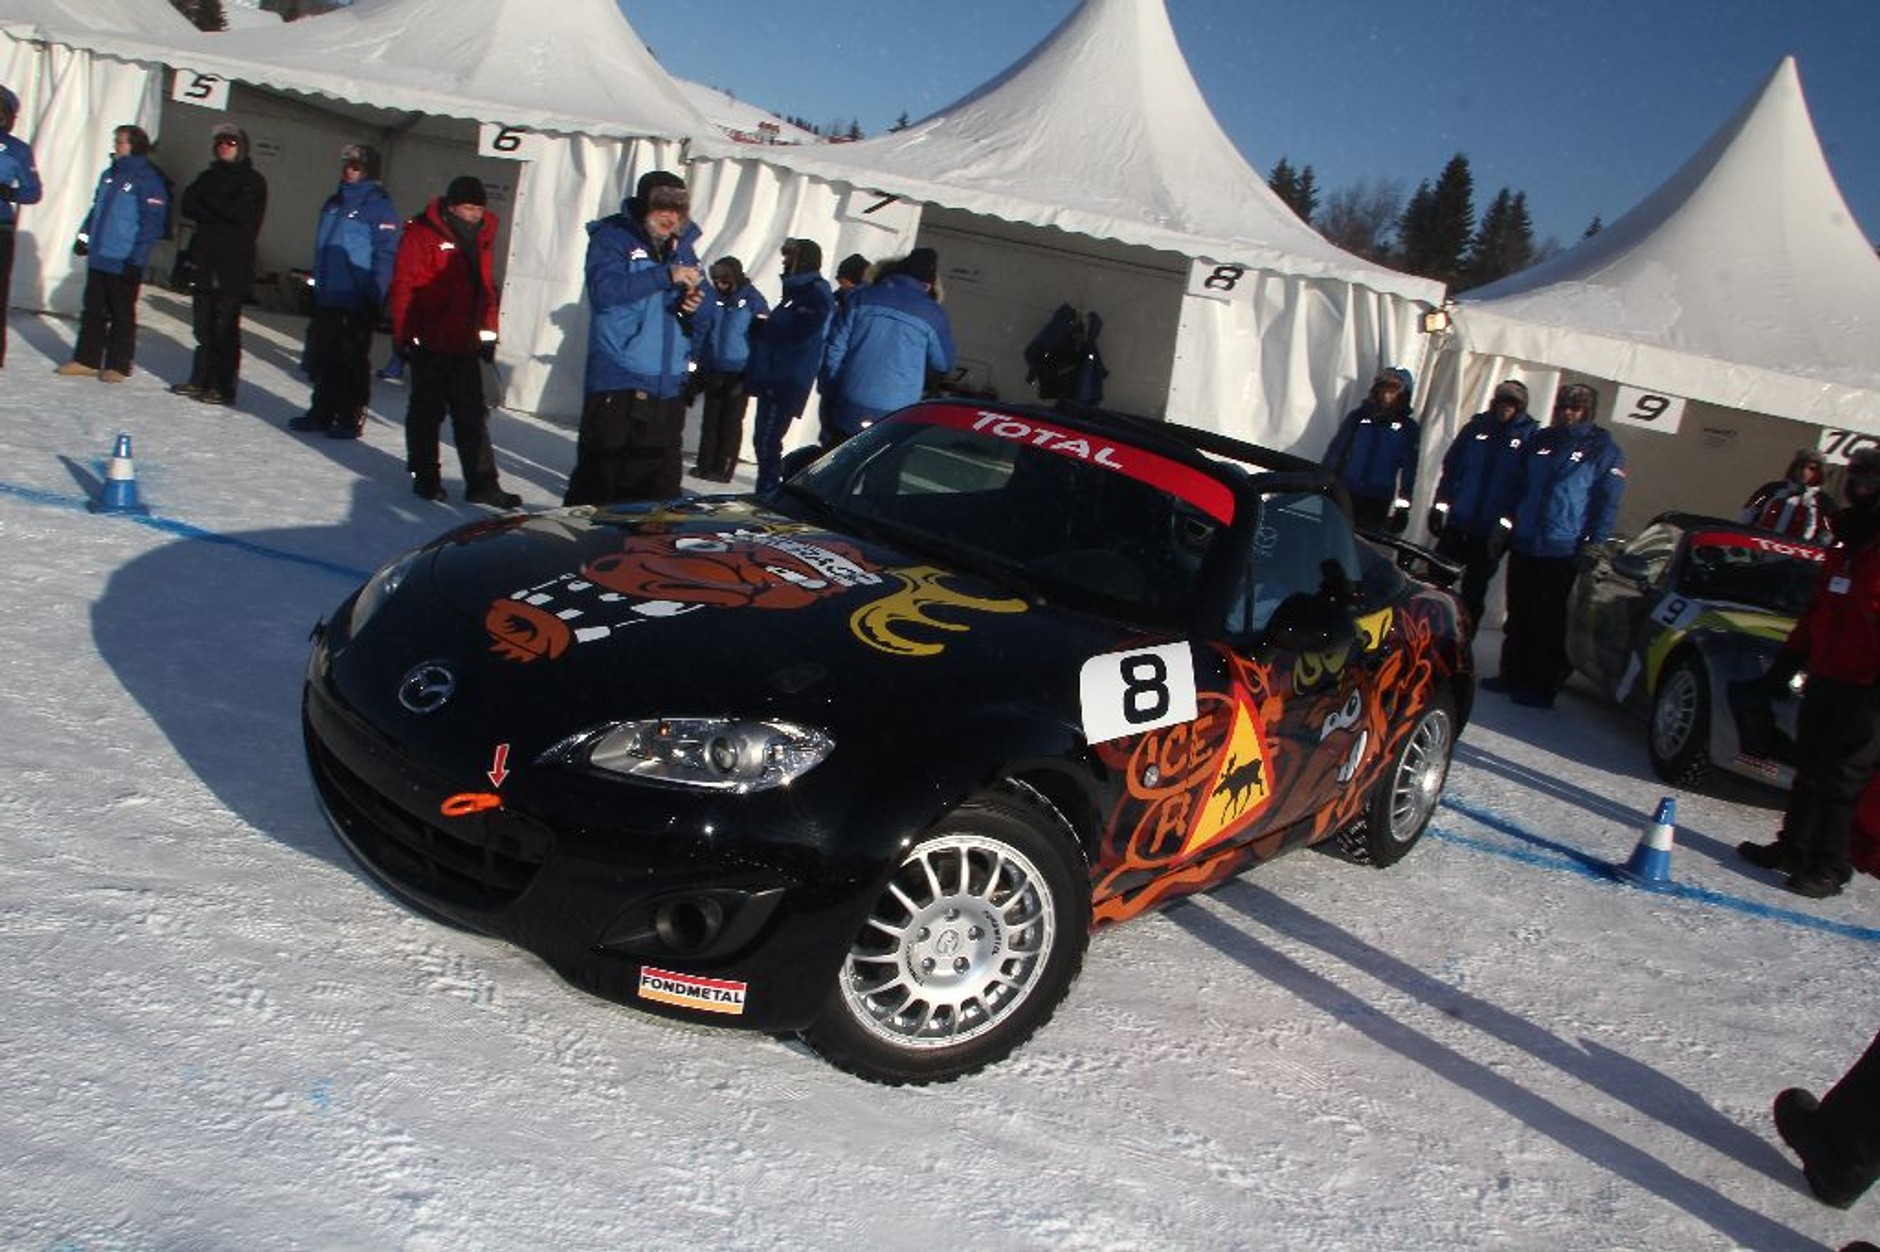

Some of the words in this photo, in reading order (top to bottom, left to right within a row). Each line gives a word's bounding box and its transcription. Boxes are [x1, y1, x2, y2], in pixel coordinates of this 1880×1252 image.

[184, 75, 218, 98] 5
[493, 126, 527, 151] 6
[863, 190, 901, 214] 7
[1204, 266, 1244, 291] 8
[1627, 395, 1670, 421] 9
[973, 411, 1123, 469] TOTAL
[1120, 653, 1169, 724] 8
[1147, 716, 1213, 776] ICE
[642, 976, 743, 1003] FONDMETAL
